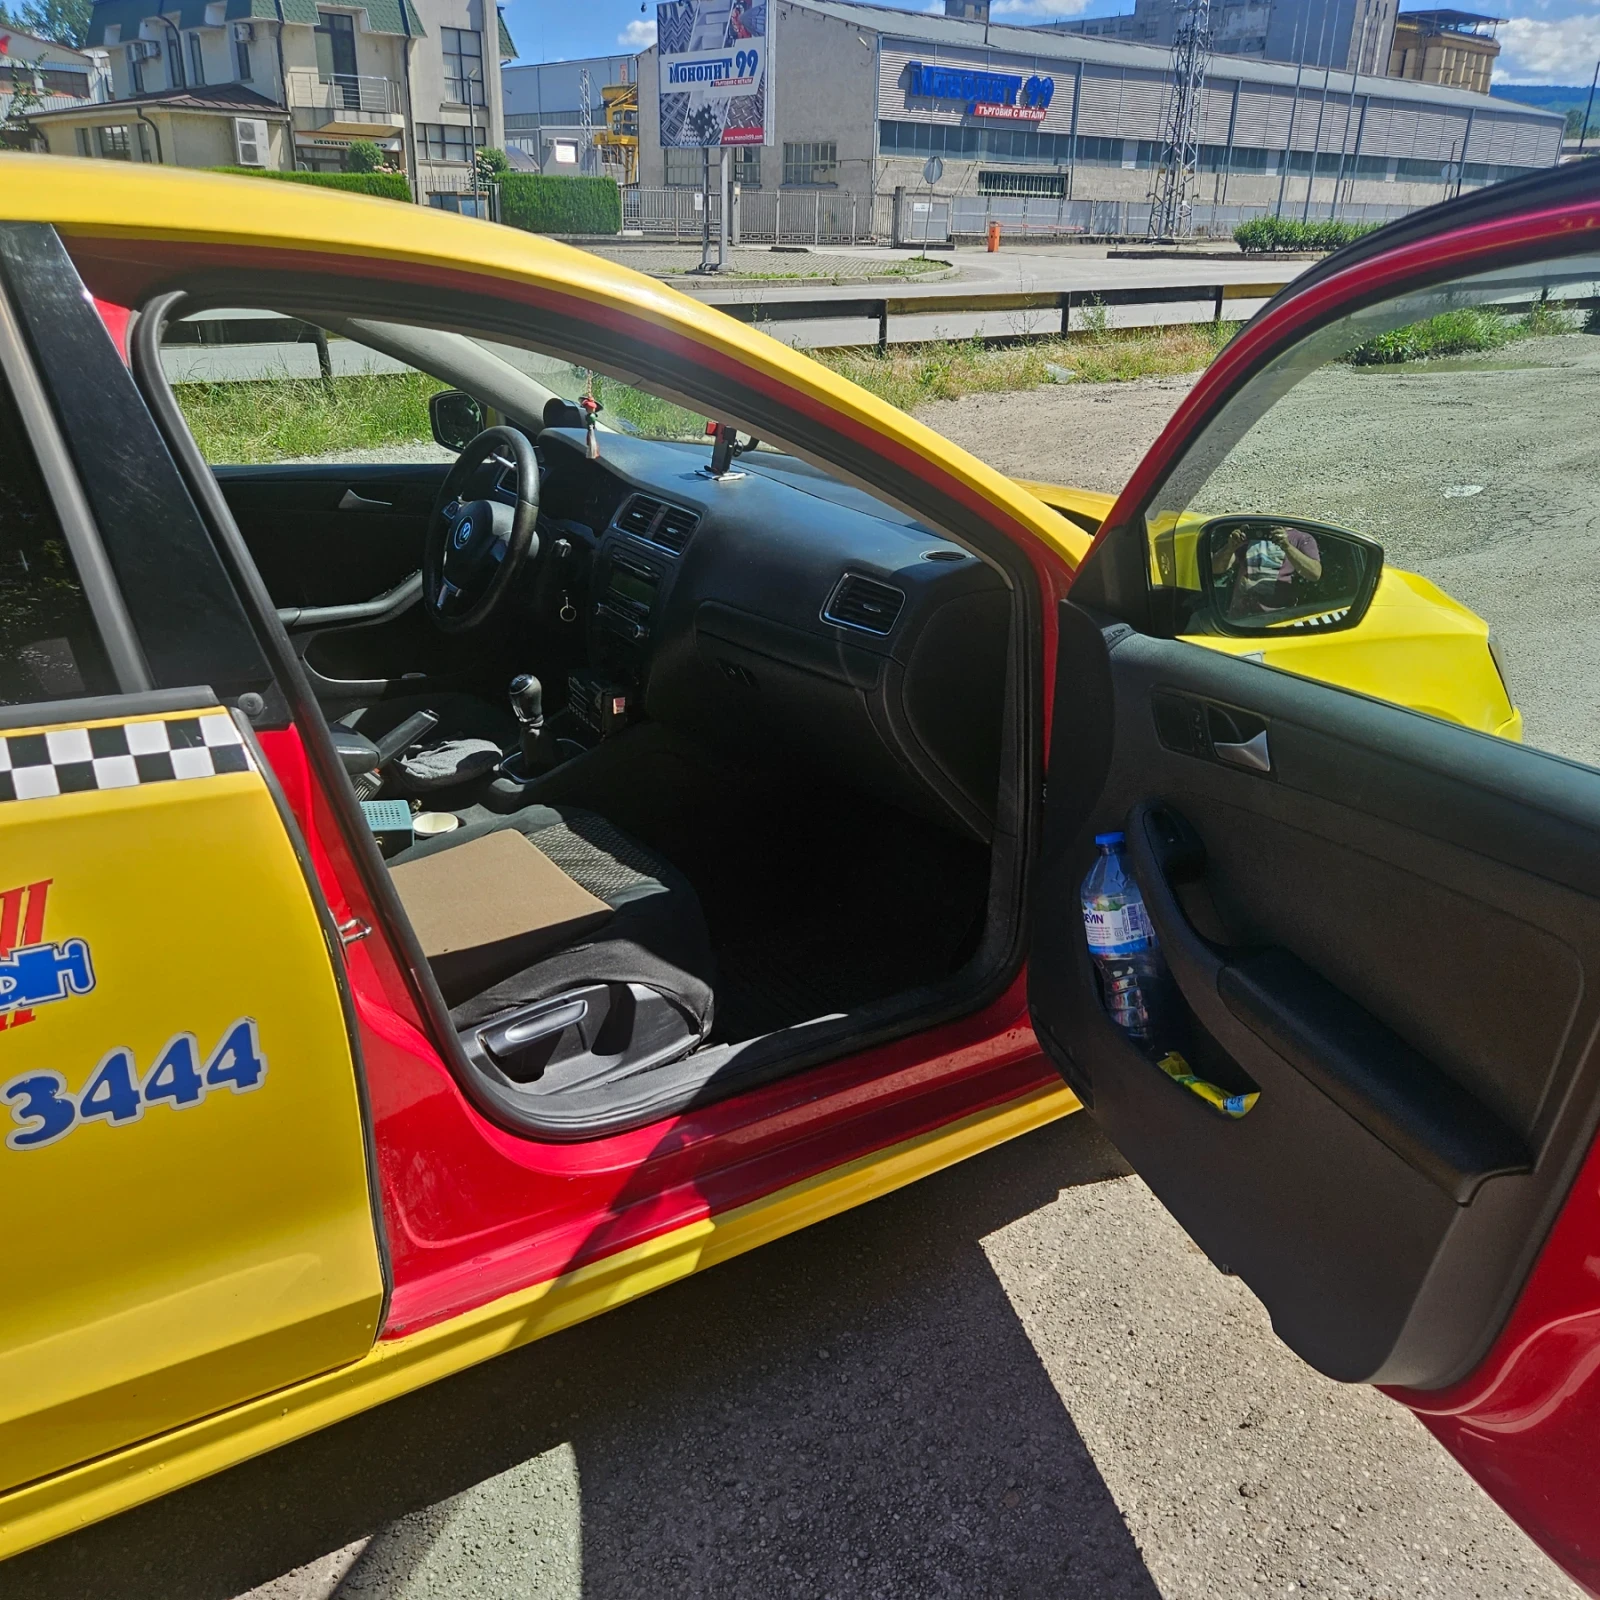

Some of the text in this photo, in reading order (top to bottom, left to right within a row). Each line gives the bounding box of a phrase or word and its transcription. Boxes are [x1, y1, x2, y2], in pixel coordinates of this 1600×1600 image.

[735, 49, 759, 78] 99
[1025, 75, 1055, 108] 99
[978, 105, 1045, 120] ТЪРГОВИЯ С МЕТАЛИ
[4, 1019, 266, 1150] 3444
